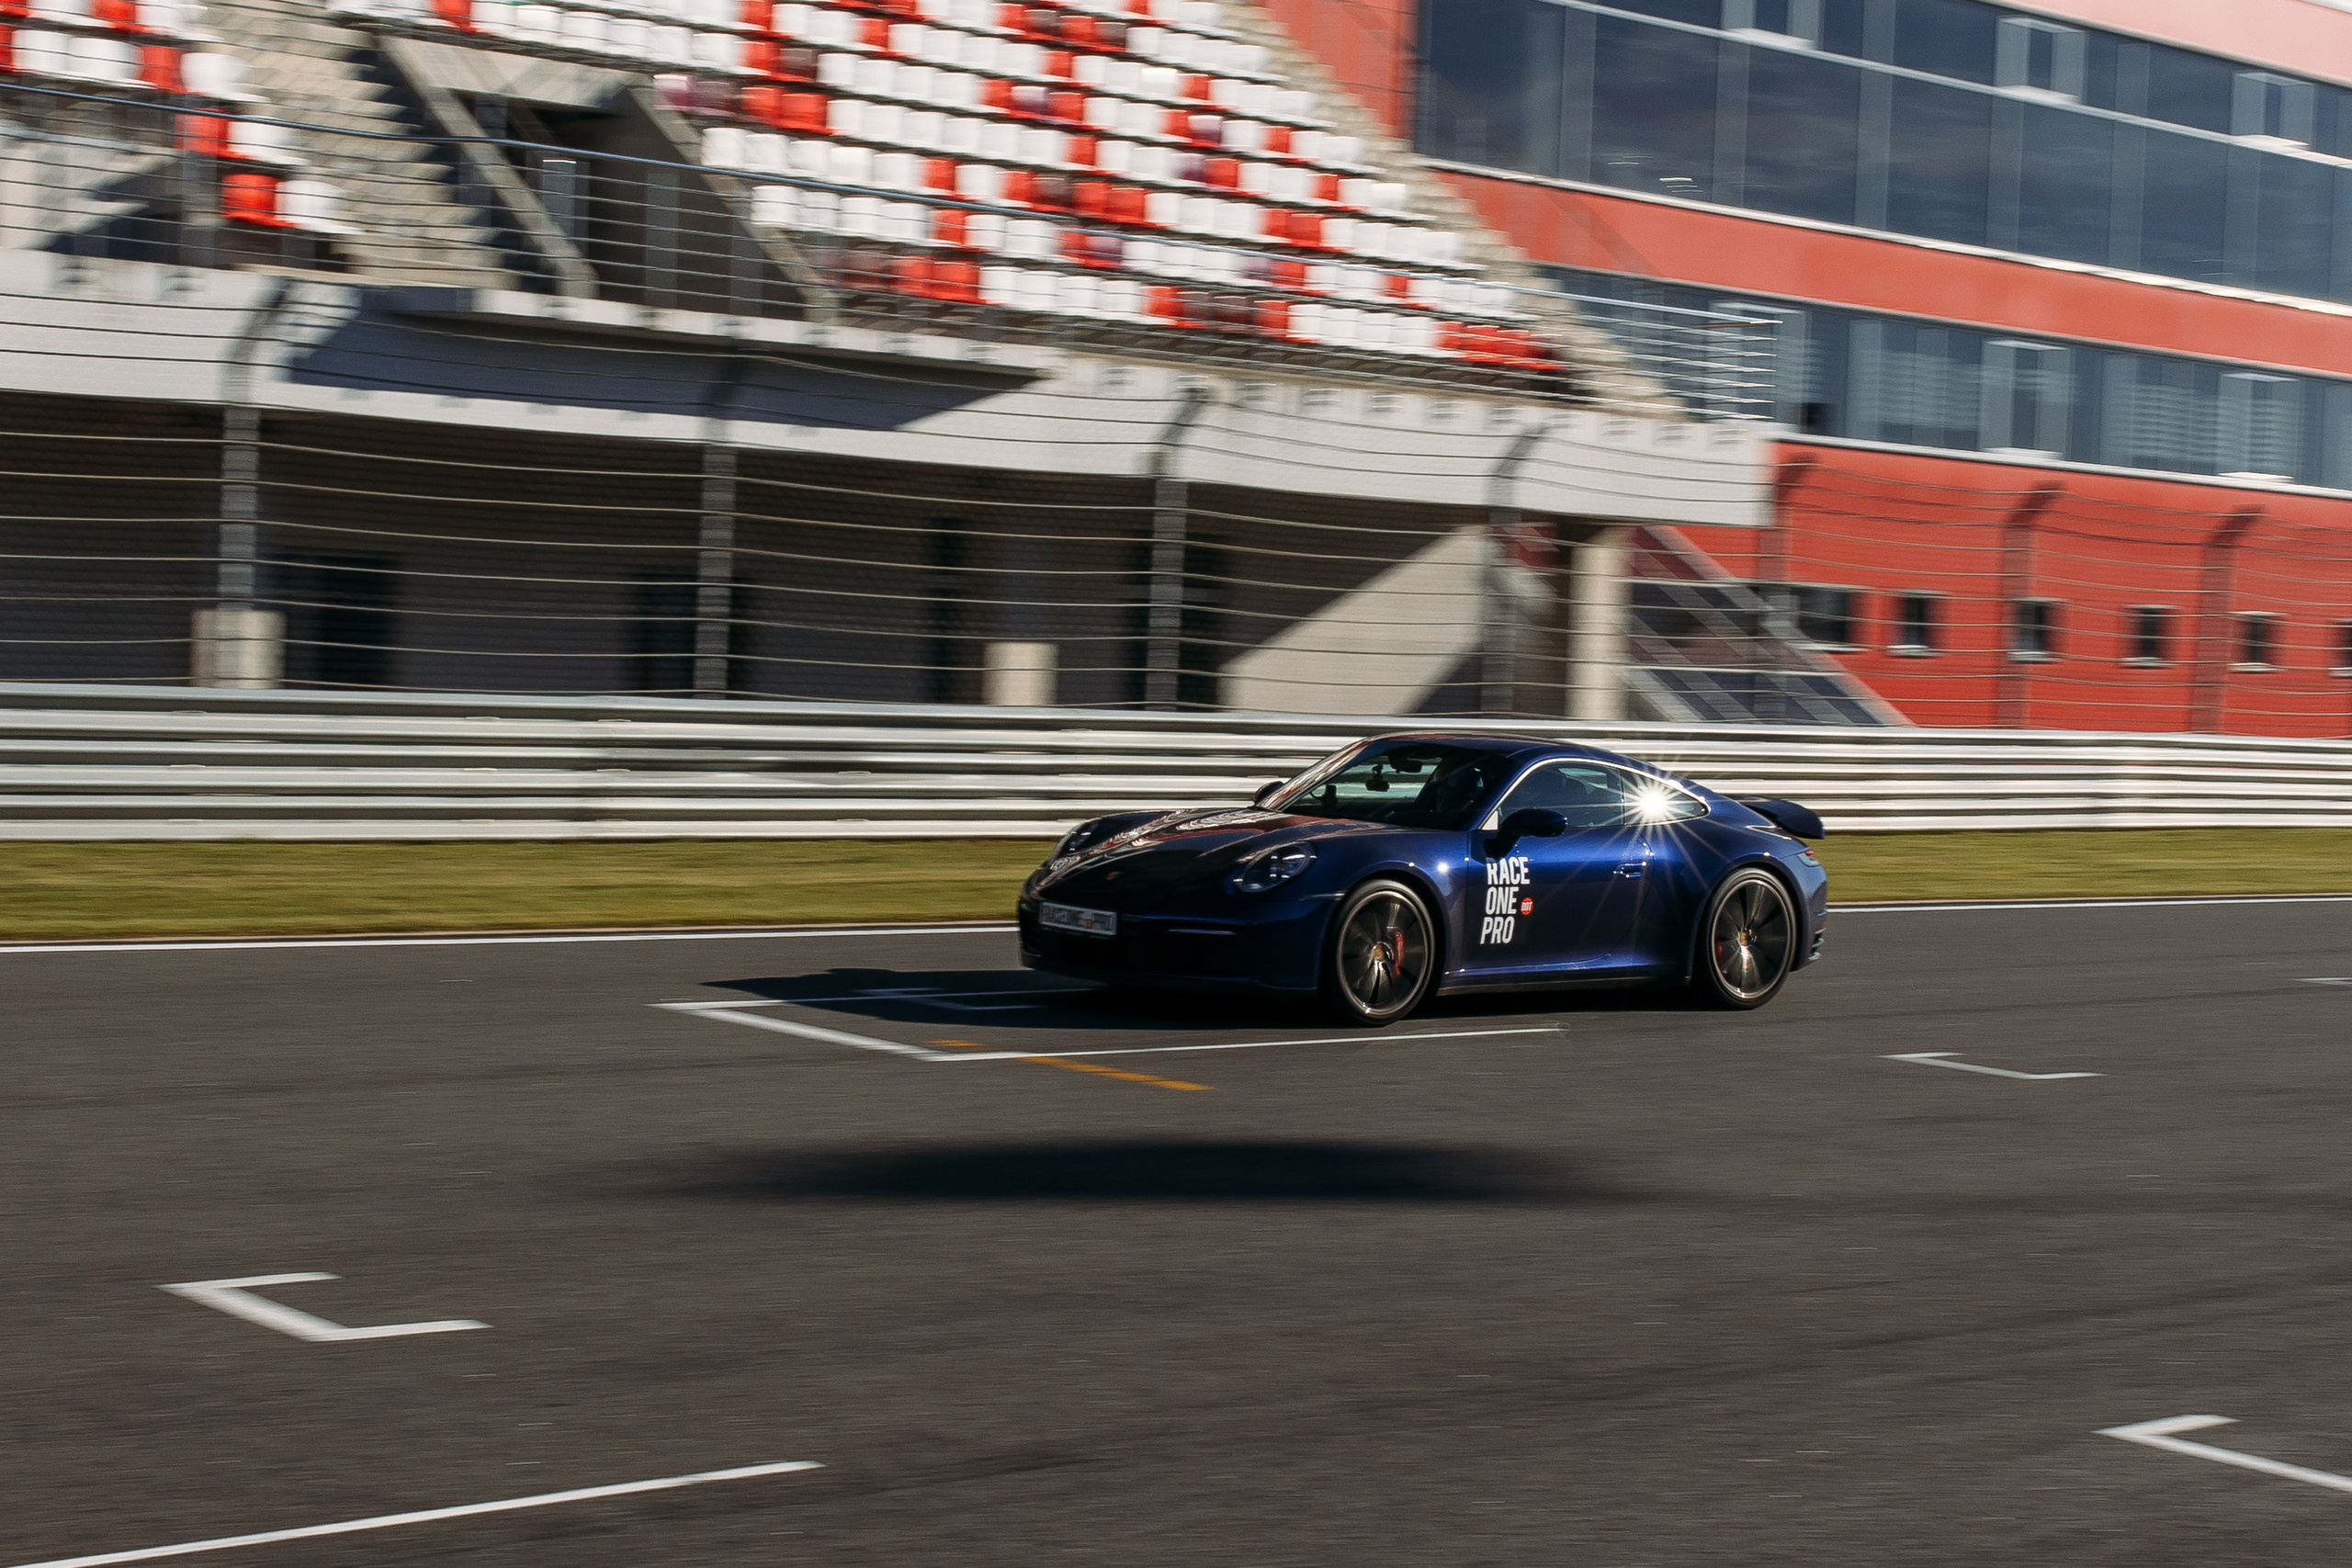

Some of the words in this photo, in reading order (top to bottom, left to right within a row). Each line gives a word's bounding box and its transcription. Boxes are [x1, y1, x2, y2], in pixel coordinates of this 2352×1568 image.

[1486, 856, 1531, 885] RACE
[1486, 886, 1520, 915] ONE
[1479, 916, 1515, 944] PRO
